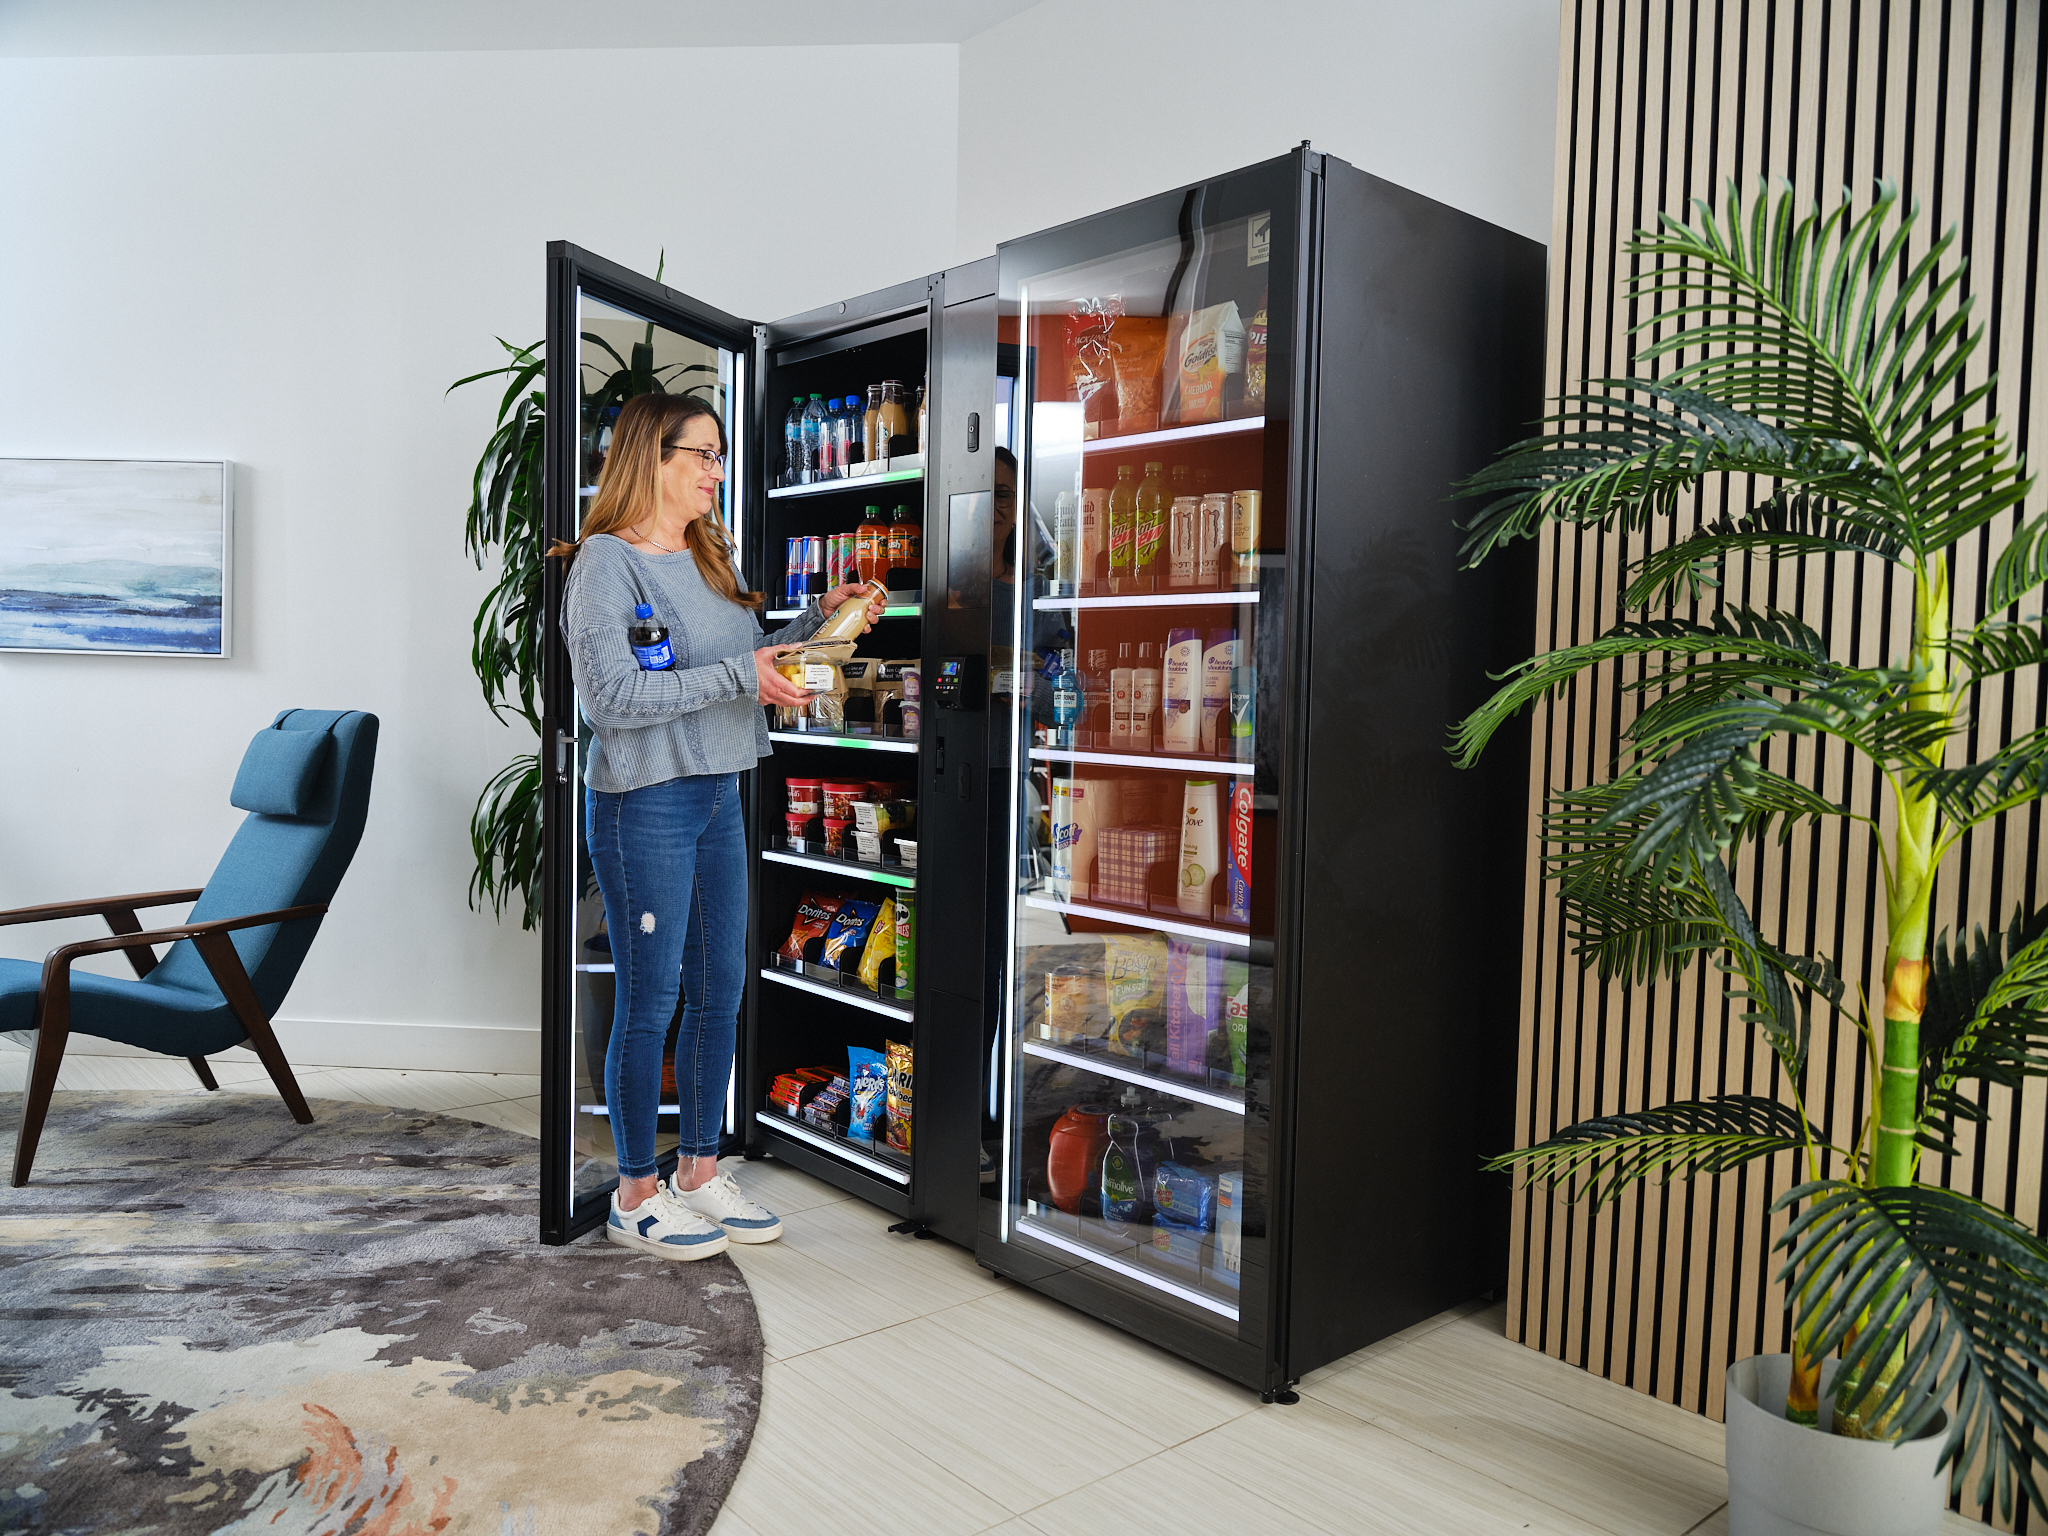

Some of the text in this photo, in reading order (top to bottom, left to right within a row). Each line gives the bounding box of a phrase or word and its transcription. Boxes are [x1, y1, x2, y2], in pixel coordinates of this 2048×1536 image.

[1184, 381, 1213, 395] CHEDDAR
[1232, 693, 1250, 701] Degree
[1055, 823, 1078, 841] Scott
[1236, 787, 1252, 868] Colgate
[1238, 879, 1246, 907] Cavity
[798, 904, 832, 921] Doritos
[836, 913, 865, 927] Doritos
